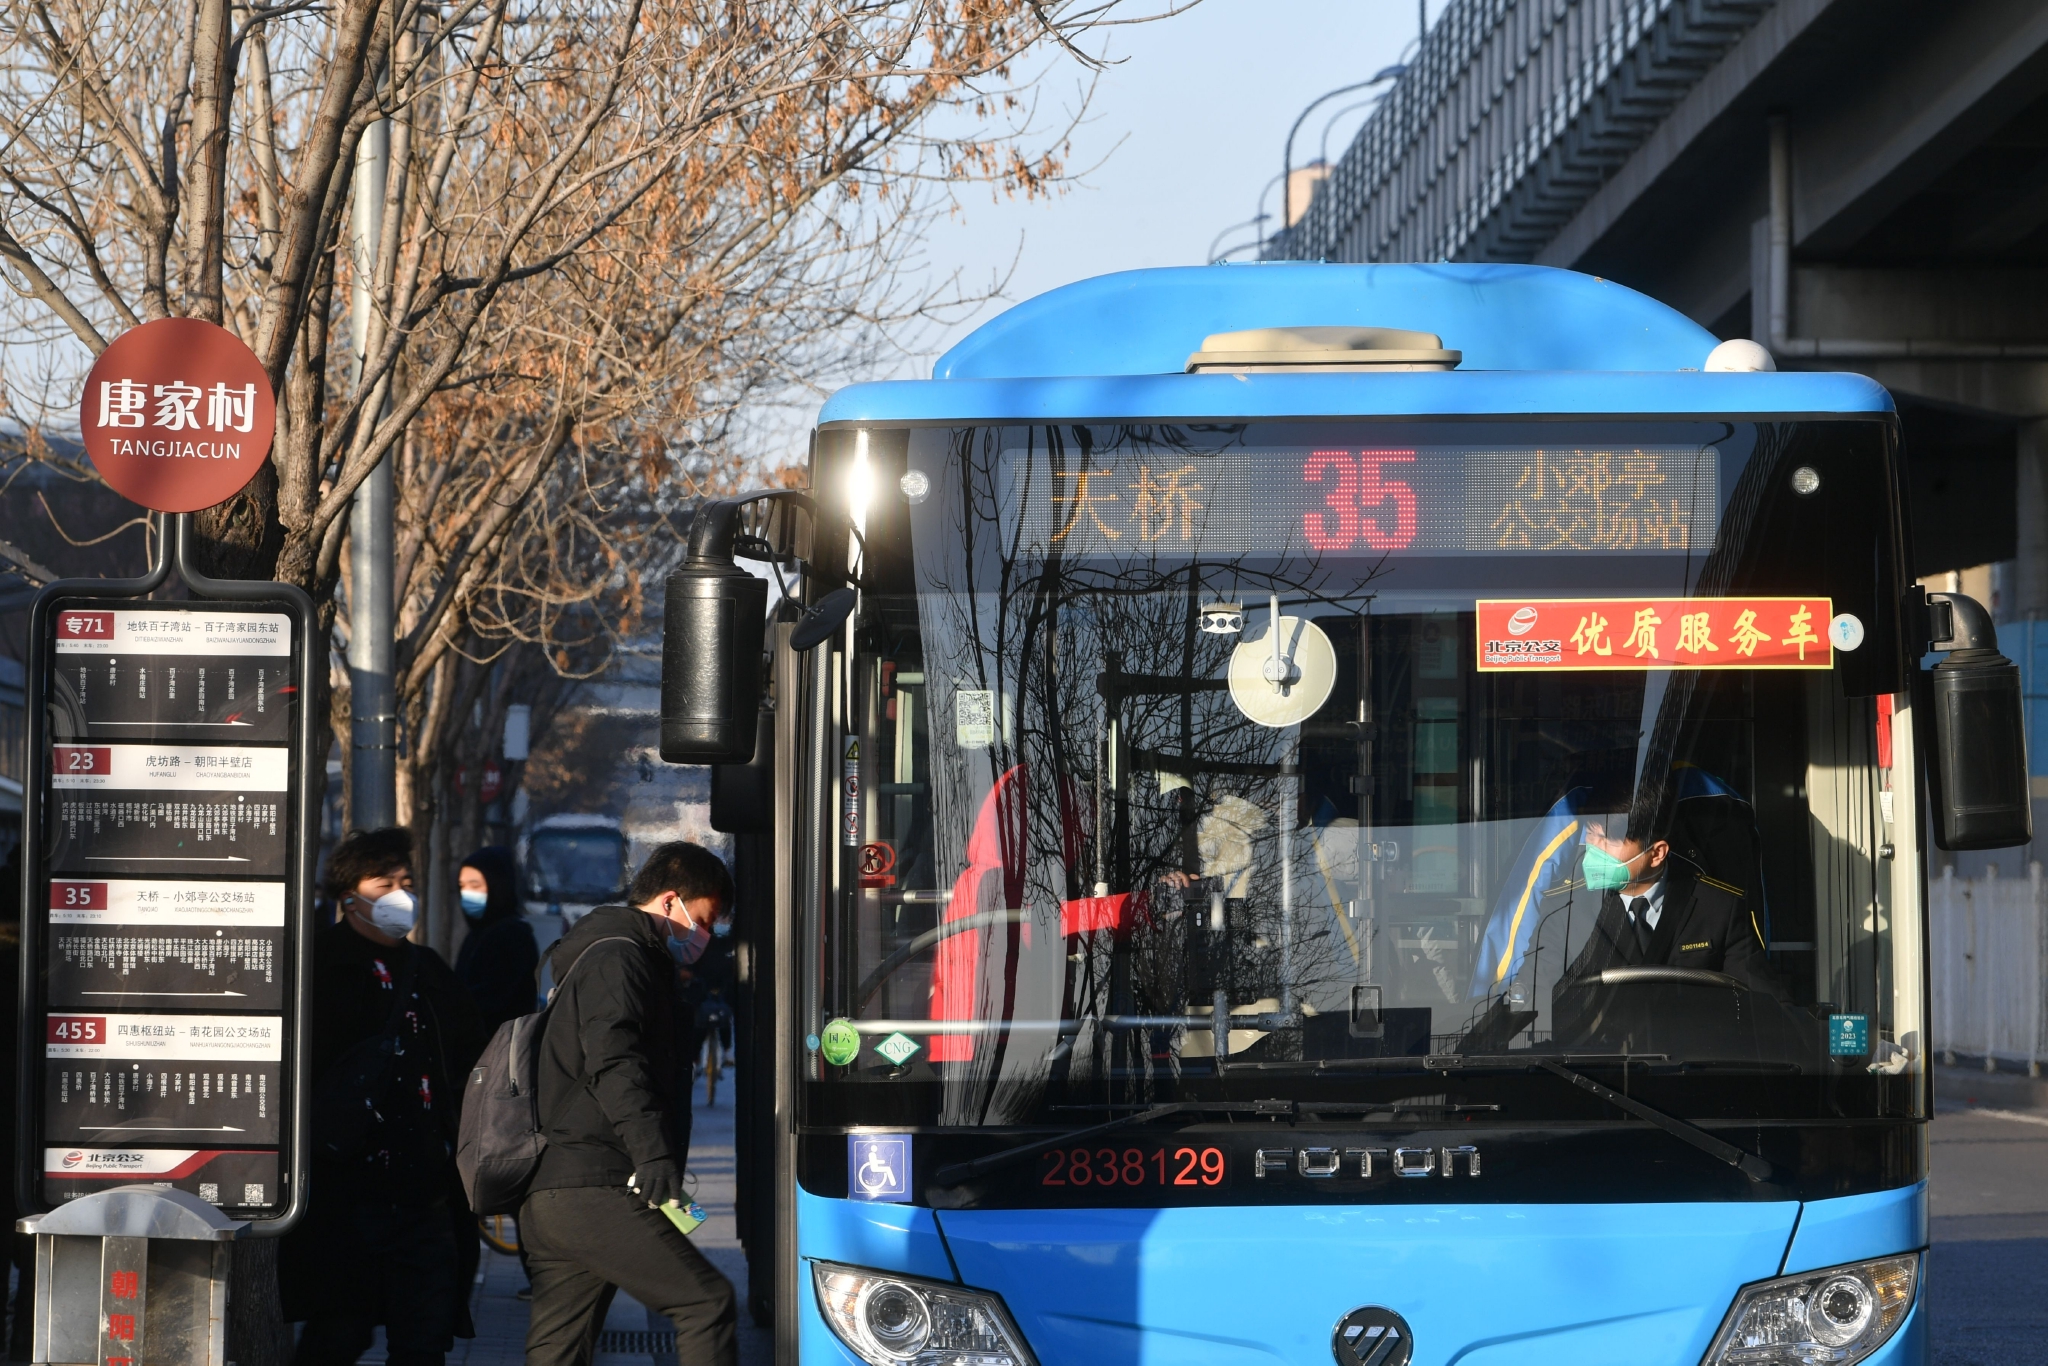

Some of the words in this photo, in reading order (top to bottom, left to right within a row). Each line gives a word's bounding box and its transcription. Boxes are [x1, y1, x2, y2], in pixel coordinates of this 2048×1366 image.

[97, 379, 257, 432] 唐家村
[110, 439, 240, 459] TANGJIACUN
[1514, 450, 1667, 501] 小郊亭
[1050, 463, 1206, 543] 天桥
[1304, 450, 1417, 551] 35
[1492, 500, 1691, 549] 公交场站
[66, 617, 104, 634] 专71
[127, 621, 191, 632] 地铁百子湾站
[205, 622, 279, 633] 百子湾家园东站
[1569, 604, 1819, 661] 优质服务车
[1485, 640, 1562, 653] 北京公交
[1485, 654, 1508, 664] Beijing
[1508, 654, 1528, 663] Public
[1528, 654, 1561, 664] Transport
[69, 753, 94, 770] 23
[146, 756, 180, 767] 虎坊路
[194, 756, 253, 768] 朝阳半壁店
[66, 888, 90, 905] 35
[137, 891, 159, 902] 天桥
[174, 891, 255, 903] 小郊亭公交场站
[56, 1022, 96, 1039] 455
[118, 1025, 175, 1037] 四惠枢纽站
[190, 1026, 271, 1038] 南花园公交场站
[829, 1033, 851, 1043] 国六
[884, 1041, 911, 1054] CNG
[88, 1154, 144, 1162] 北京公交
[1042, 1147, 1225, 1186] 2838129
[1254, 1146, 1482, 1179] FOTON
